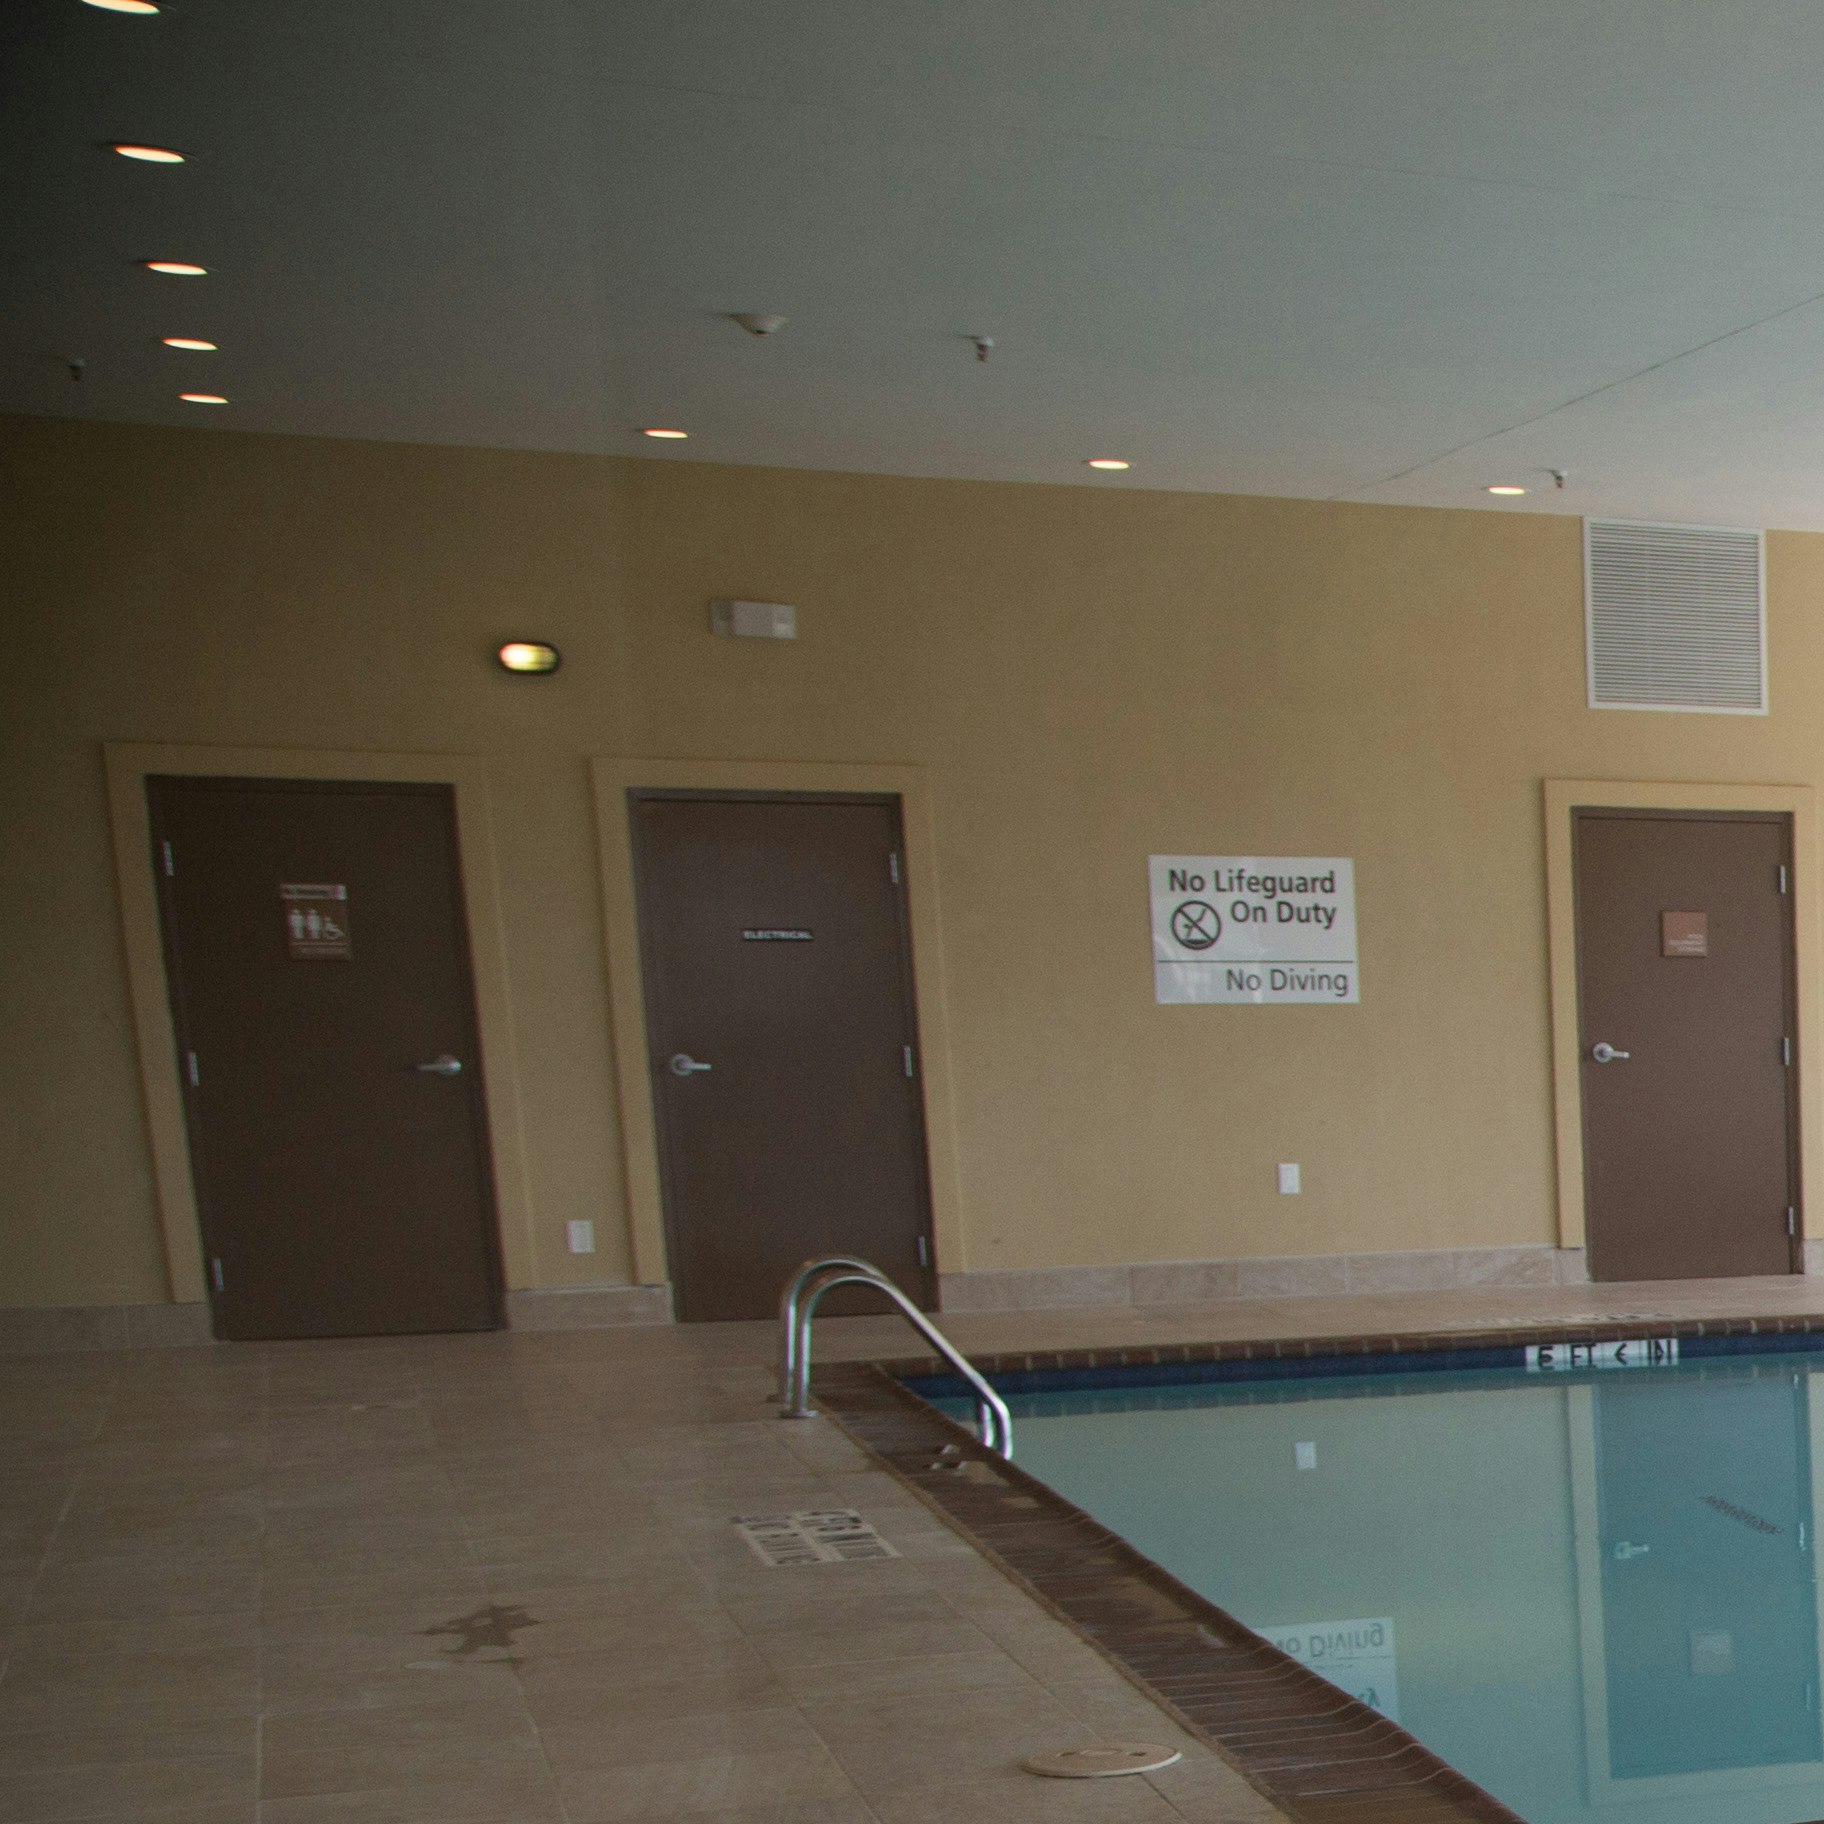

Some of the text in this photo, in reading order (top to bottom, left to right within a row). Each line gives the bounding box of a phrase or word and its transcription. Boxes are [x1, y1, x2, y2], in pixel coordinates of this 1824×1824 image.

[1168, 868, 1336, 899] No Lifeguard
[1231, 901, 1336, 930] On Duty
[1226, 968, 1348, 997] No Diving
